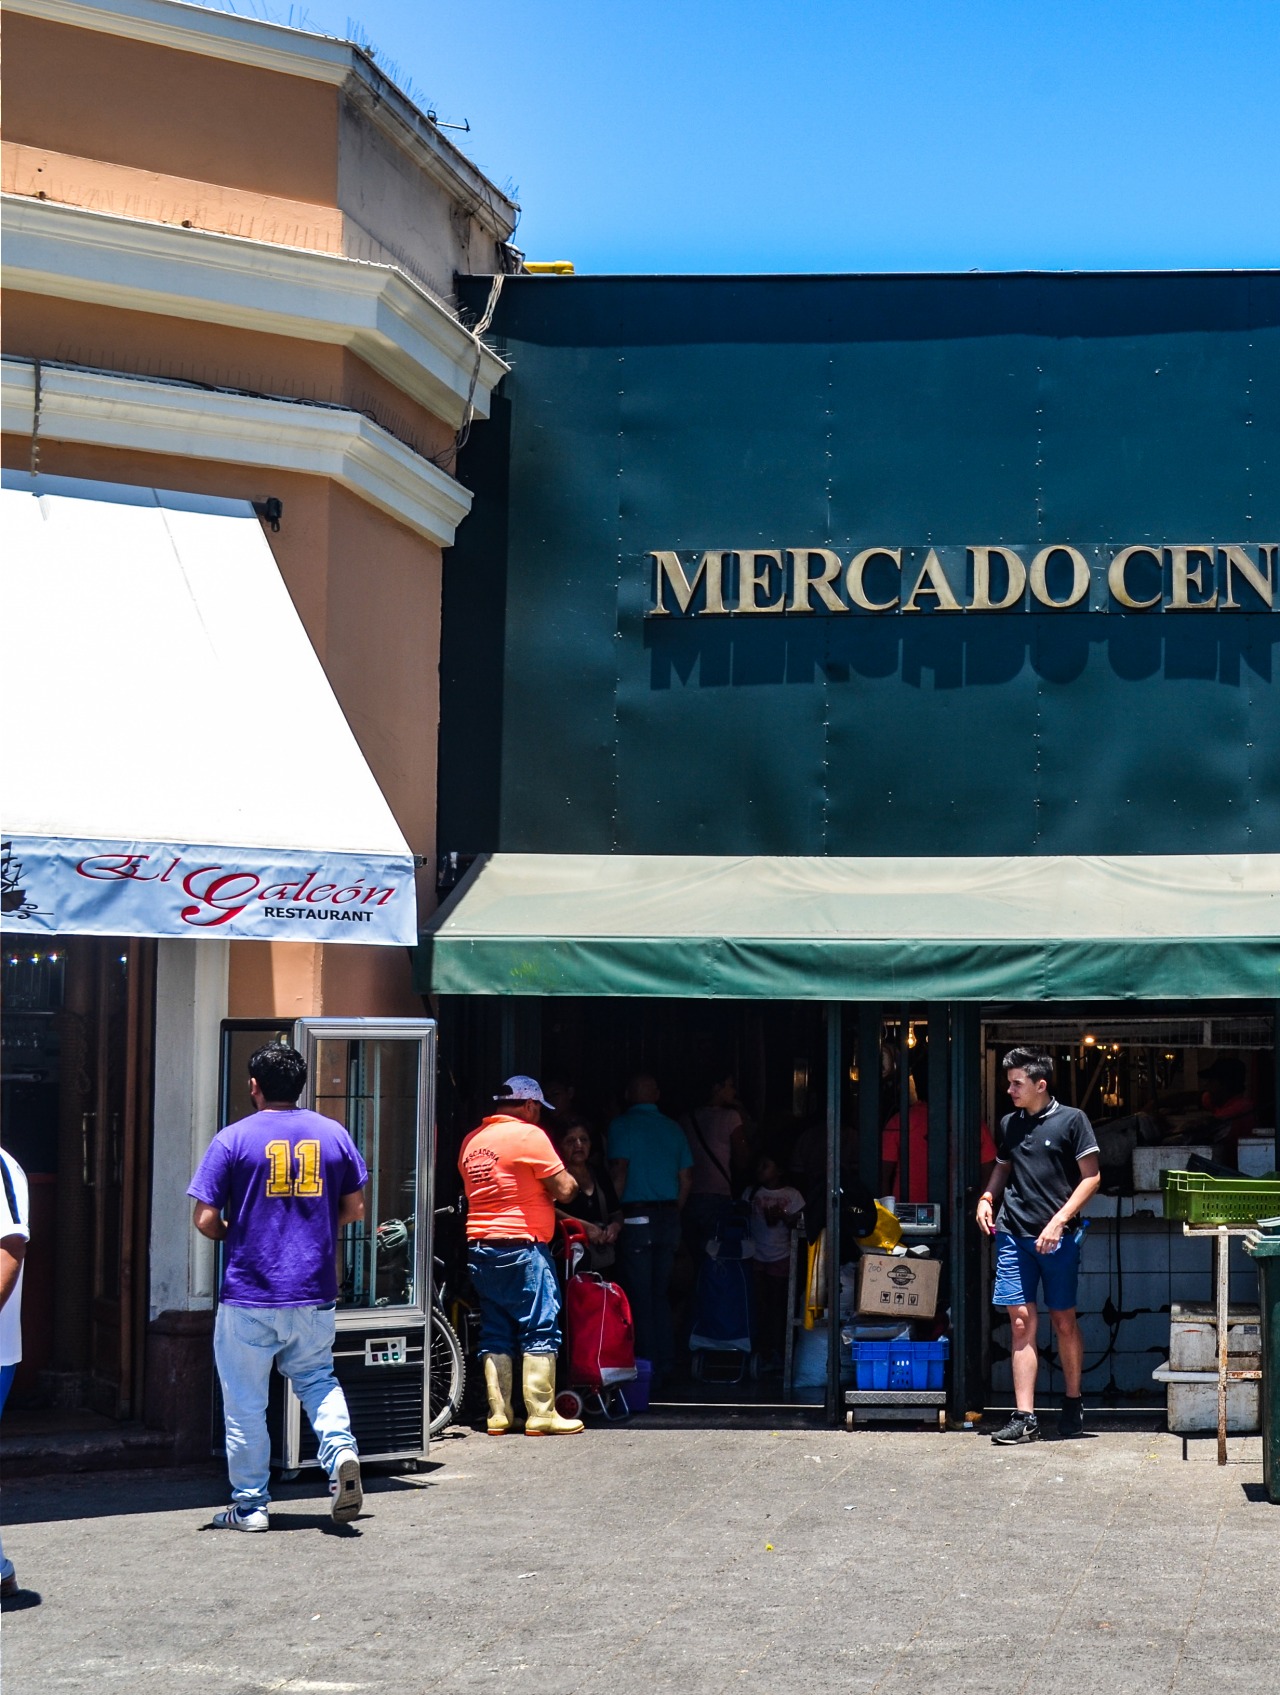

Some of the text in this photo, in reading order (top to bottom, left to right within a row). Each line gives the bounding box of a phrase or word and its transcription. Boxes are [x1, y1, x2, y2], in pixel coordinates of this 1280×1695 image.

[649, 545, 1091, 614] MERCADO
[76, 854, 396, 927] El Galeón
[264, 906, 373, 922] RESTAURANT
[265, 1139, 323, 1197] 11
